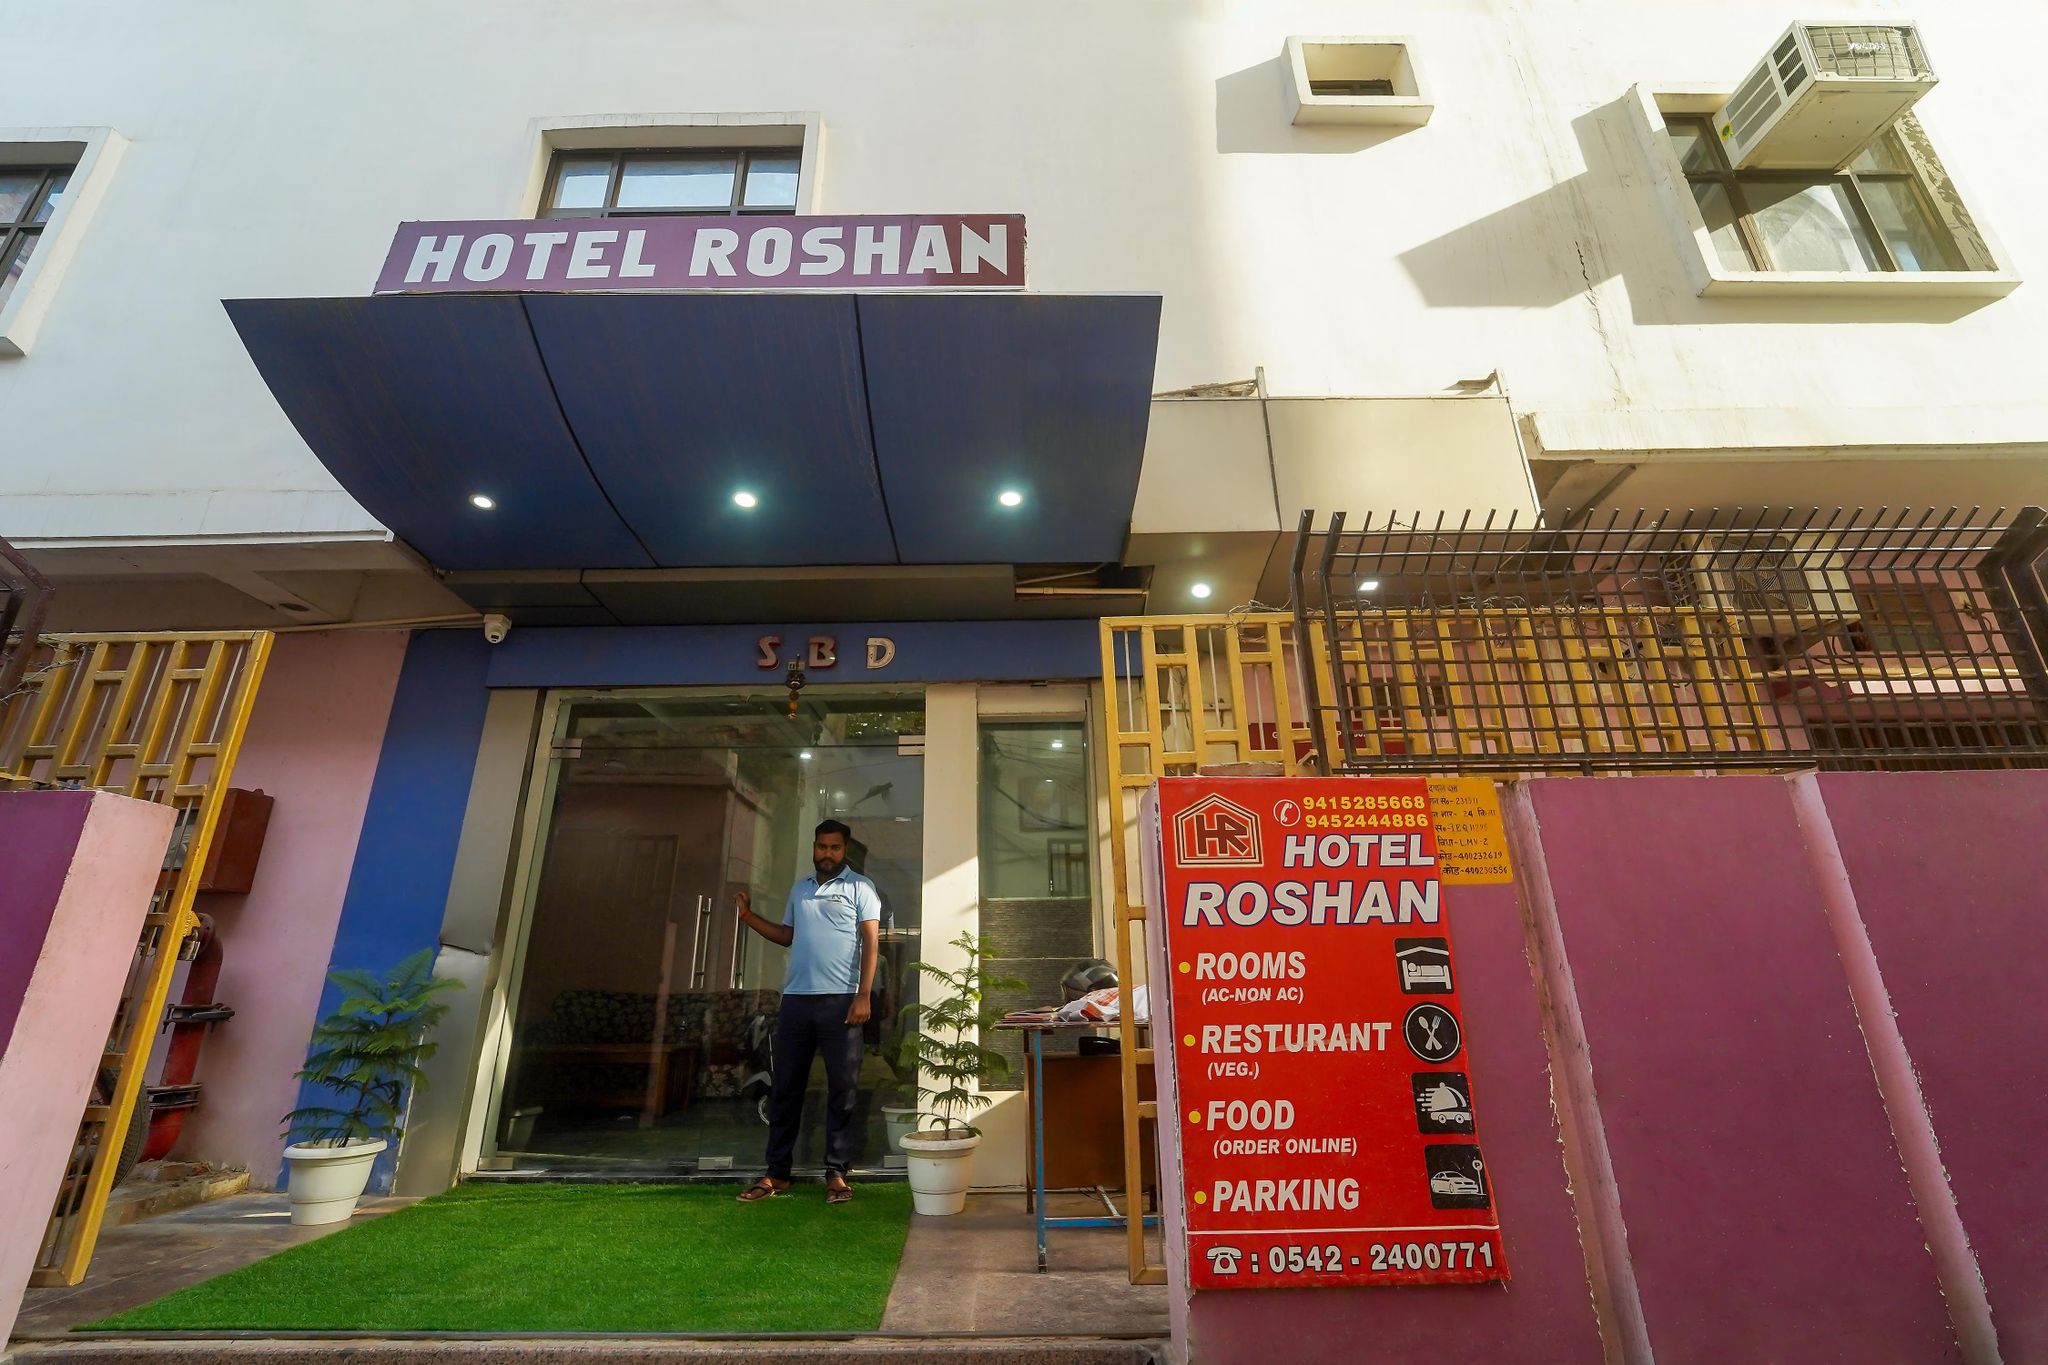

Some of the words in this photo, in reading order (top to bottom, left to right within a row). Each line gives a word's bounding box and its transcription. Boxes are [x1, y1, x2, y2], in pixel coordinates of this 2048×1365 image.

[403, 230, 657, 283] HOTEL
[688, 224, 1008, 277] ROSHAN
[1303, 796, 1425, 810] 9415285668
[1305, 814, 1429, 828] 9452444886
[1283, 833, 1435, 868] HOTEL
[1182, 878, 1440, 927] ROSHAN
[1196, 951, 1306, 981] ROOMS
[1201, 987, 1272, 1005] (AC-NON
[1276, 986, 1304, 1004] AC)
[1201, 1022, 1392, 1054] RESTURANT
[1207, 1061, 1260, 1080] (VEG.)
[1206, 1099, 1295, 1131] FOOD
[1212, 1139, 1280, 1159] (ORDER
[1285, 1137, 1358, 1156] ONLINE)
[1212, 1177, 1360, 1212] PARKING
[1268, 1245, 1343, 1273] 0542
[1370, 1241, 1494, 1272] 2400771
